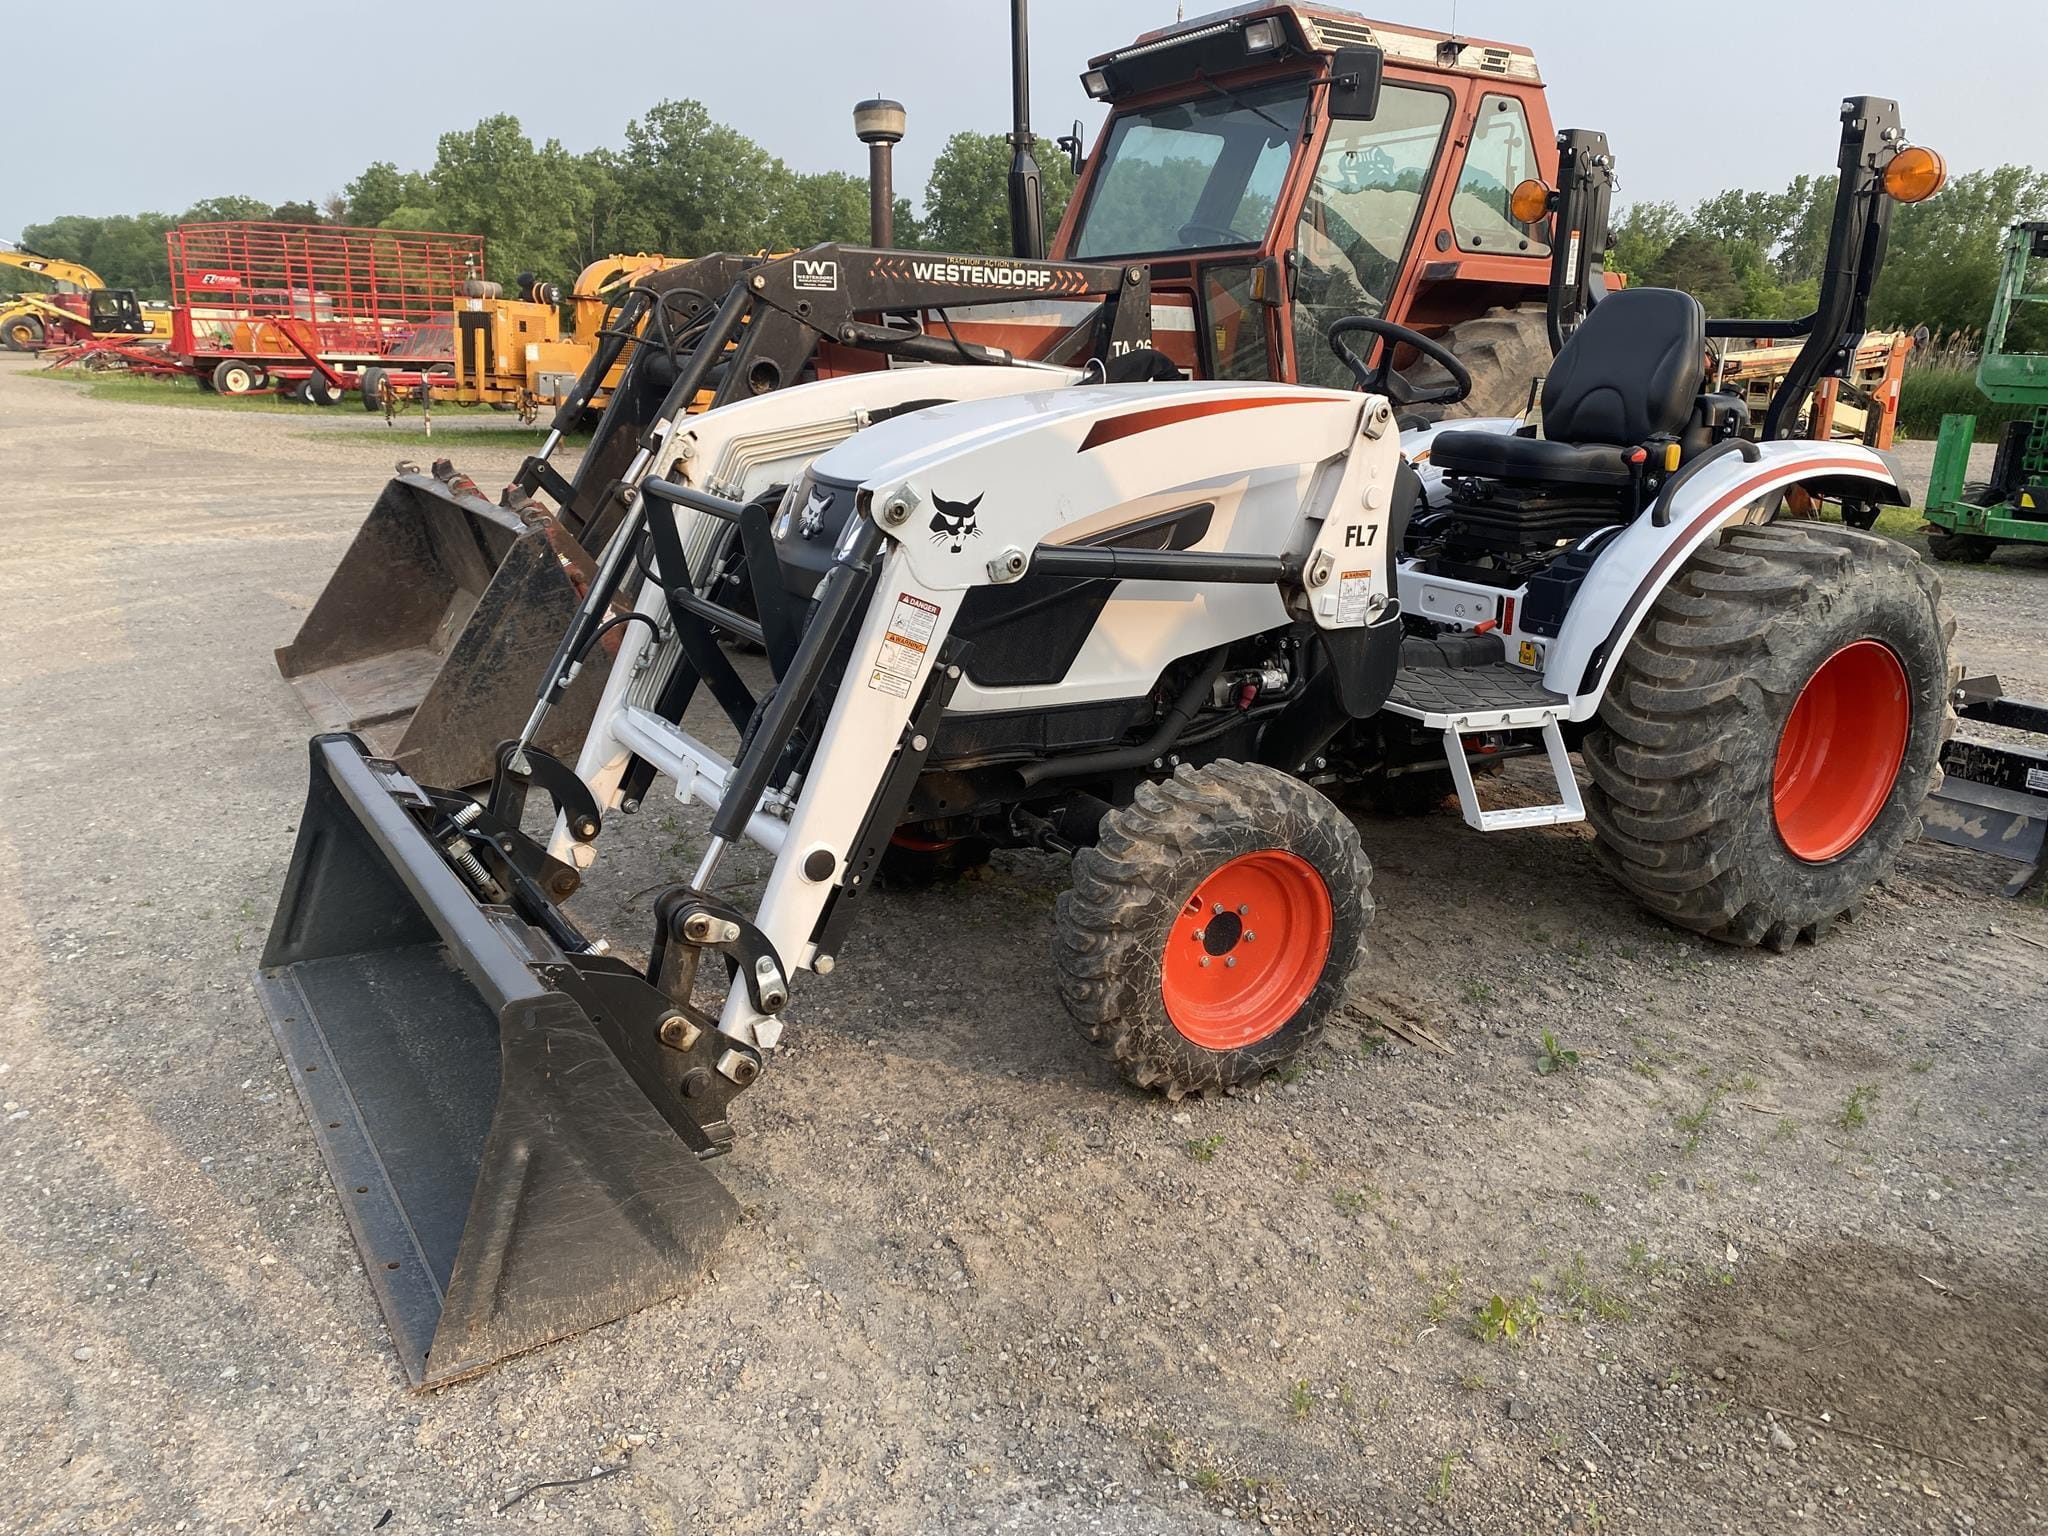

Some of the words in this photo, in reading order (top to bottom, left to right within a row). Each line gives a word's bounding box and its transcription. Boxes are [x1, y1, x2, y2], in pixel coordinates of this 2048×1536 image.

[946, 256, 980, 266] TRACTION
[985, 260, 1009, 268] ACTION
[912, 262, 1051, 287] WESTENDORF
[1345, 524, 1378, 548] FL7
[910, 599, 937, 614] DANGER
[896, 636, 923, 651] WARNING
